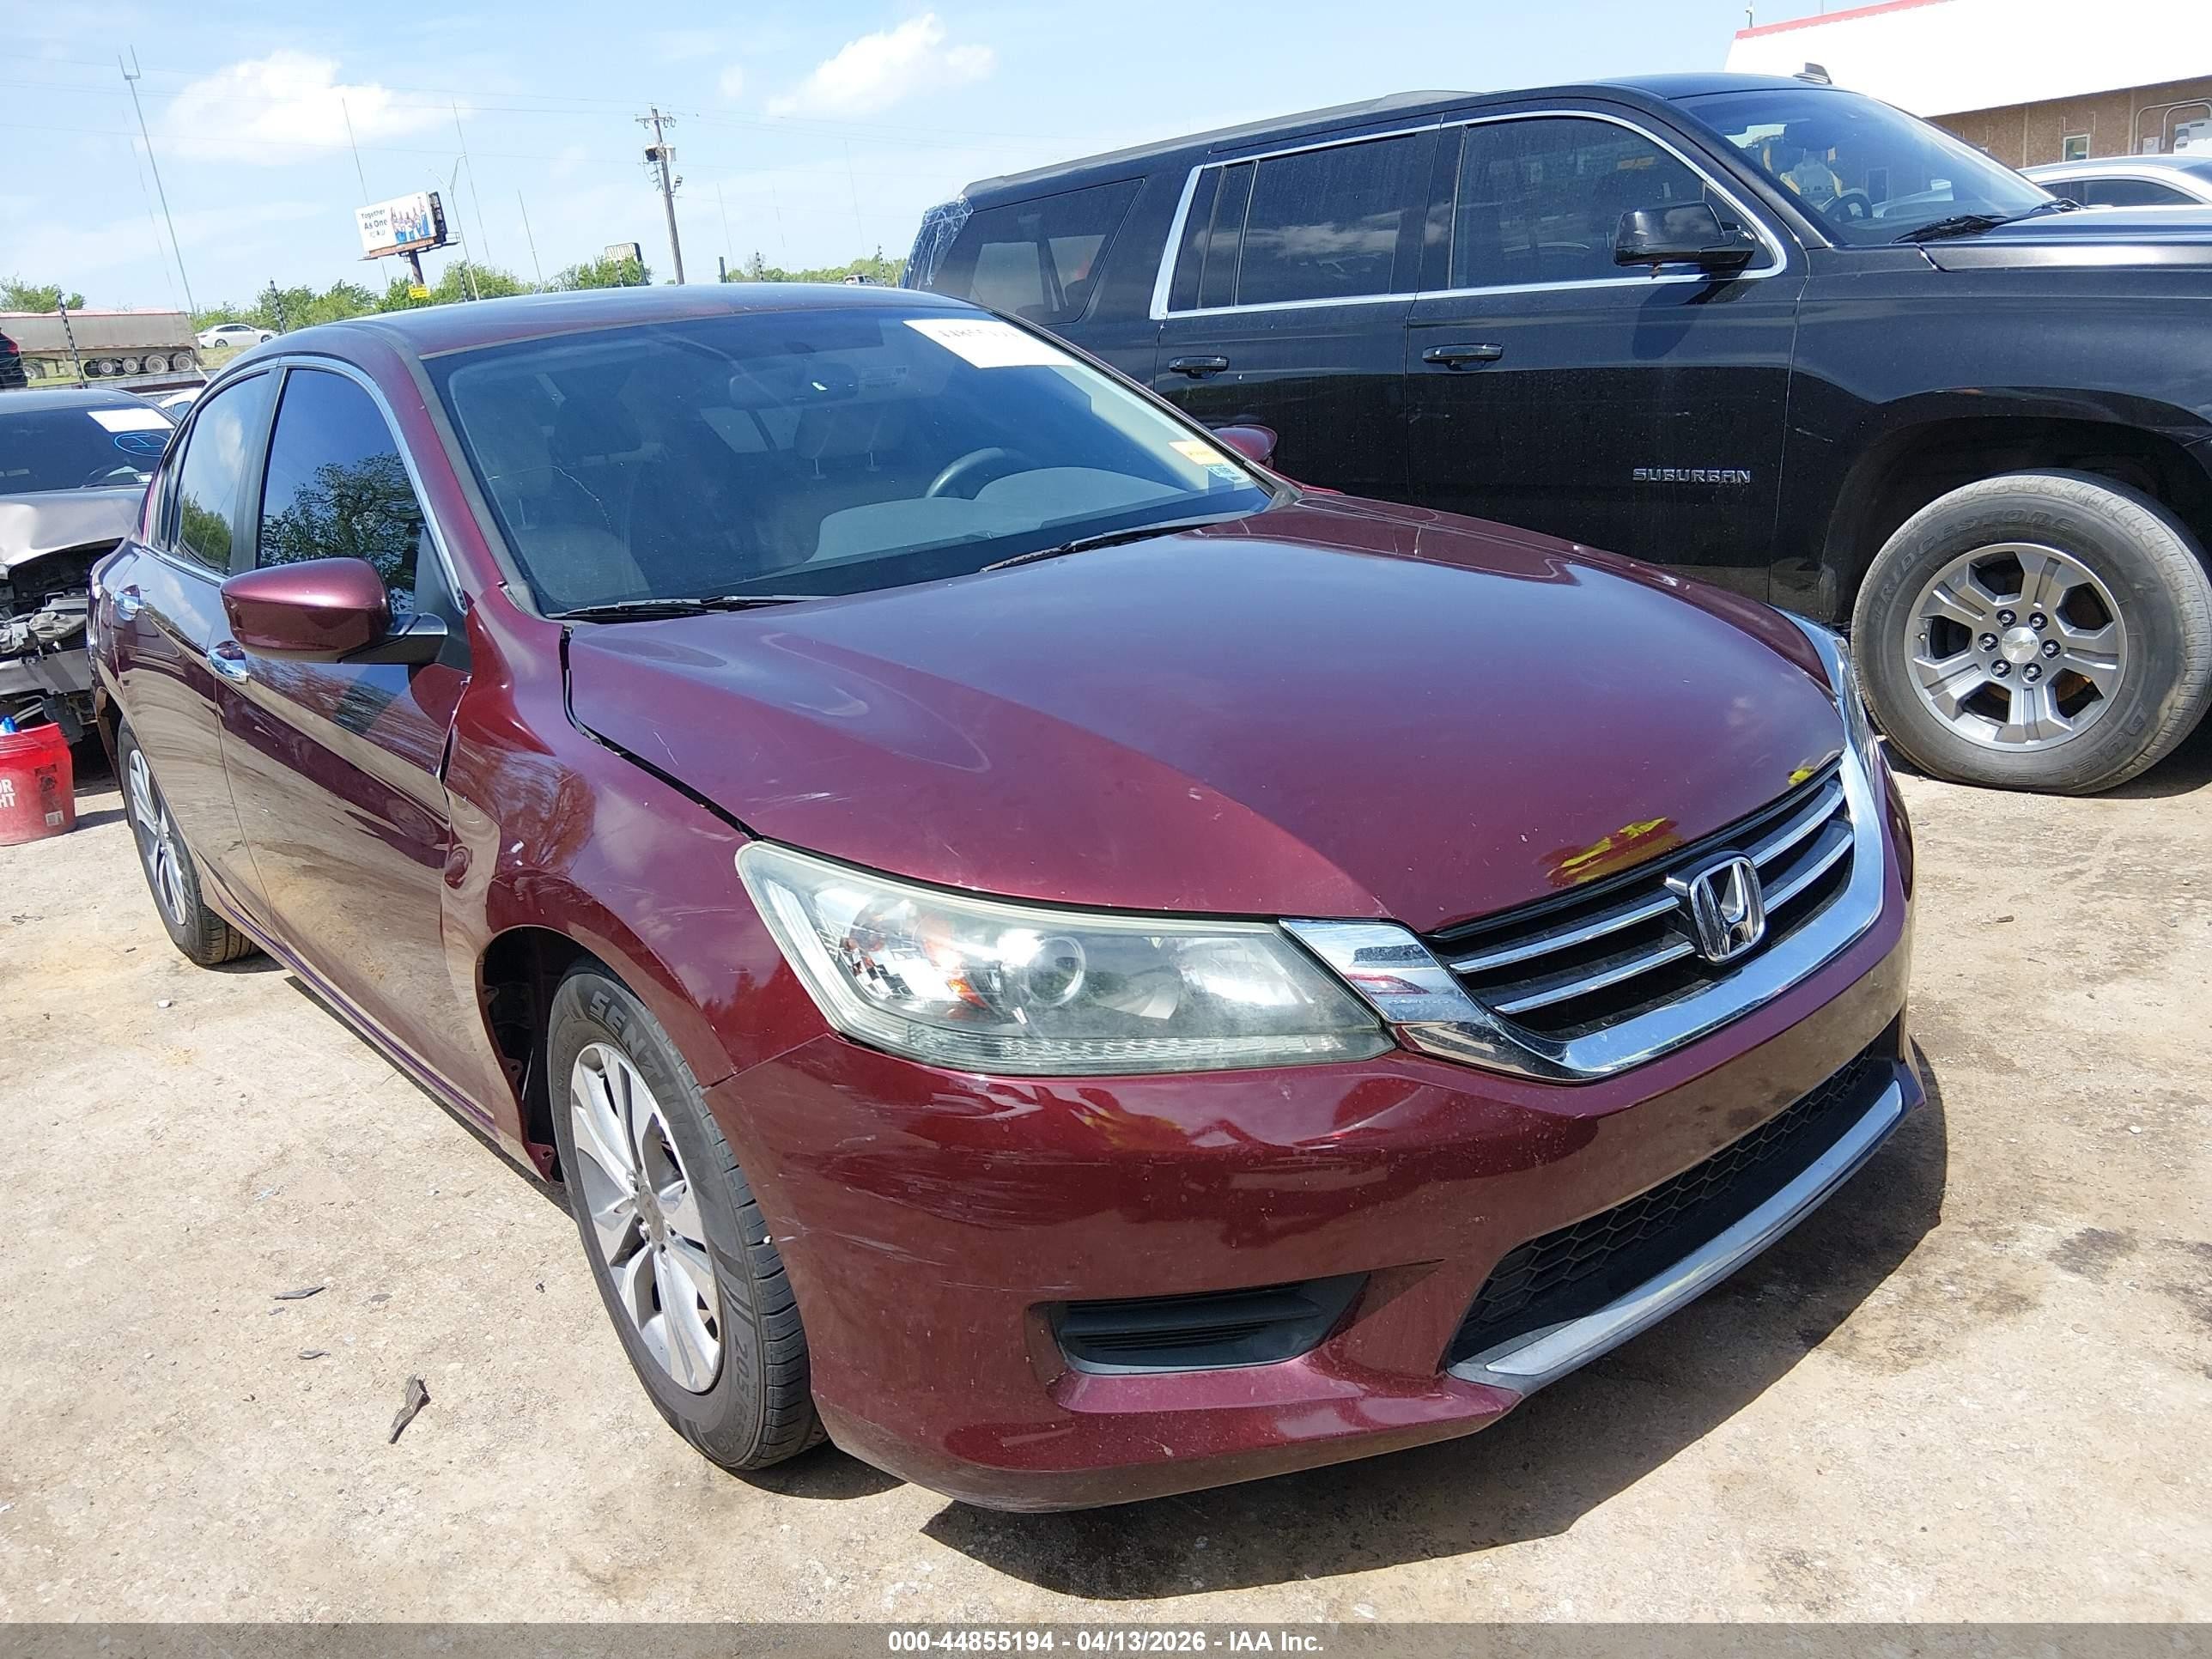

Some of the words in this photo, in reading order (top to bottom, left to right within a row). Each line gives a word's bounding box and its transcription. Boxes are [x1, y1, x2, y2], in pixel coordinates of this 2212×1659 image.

[362, 209, 385, 219] Together
[364, 222, 373, 230] As
[374, 219, 388, 228] One
[1632, 468, 1751, 483] SUBURBAN
[0, 779, 15, 793] R
